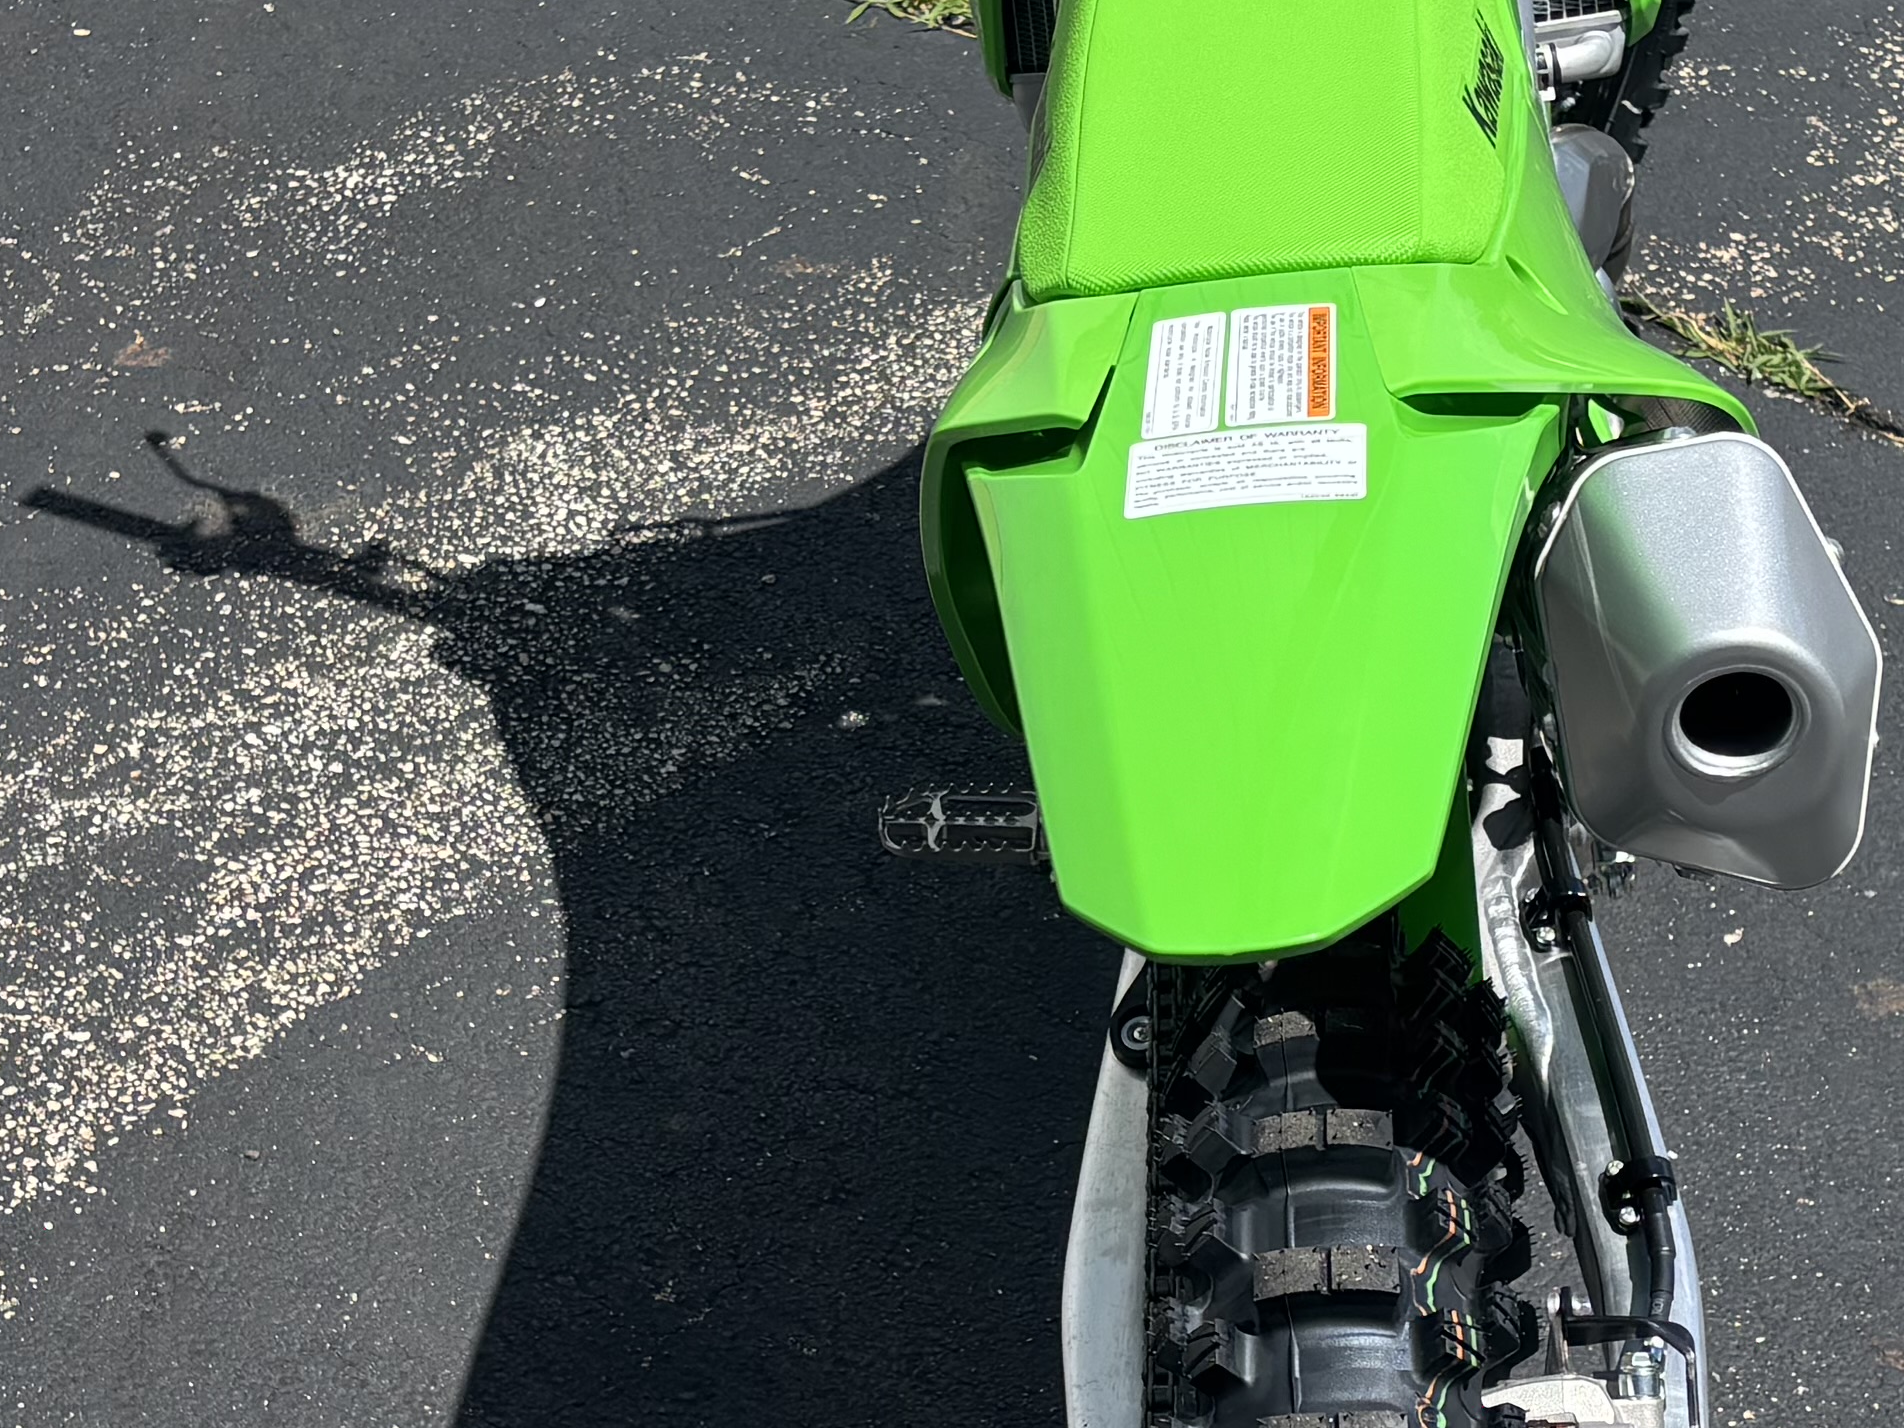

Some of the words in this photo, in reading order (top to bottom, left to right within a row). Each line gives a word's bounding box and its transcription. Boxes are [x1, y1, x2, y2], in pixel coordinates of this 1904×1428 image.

[1312, 312, 1328, 353] IMPORTANT
[1311, 357, 1328, 410] INFORMATION
[1154, 435, 1233, 451] DISCLAIMER
[1239, 433, 1257, 441] OF
[1264, 429, 1341, 439] WARRANTY
